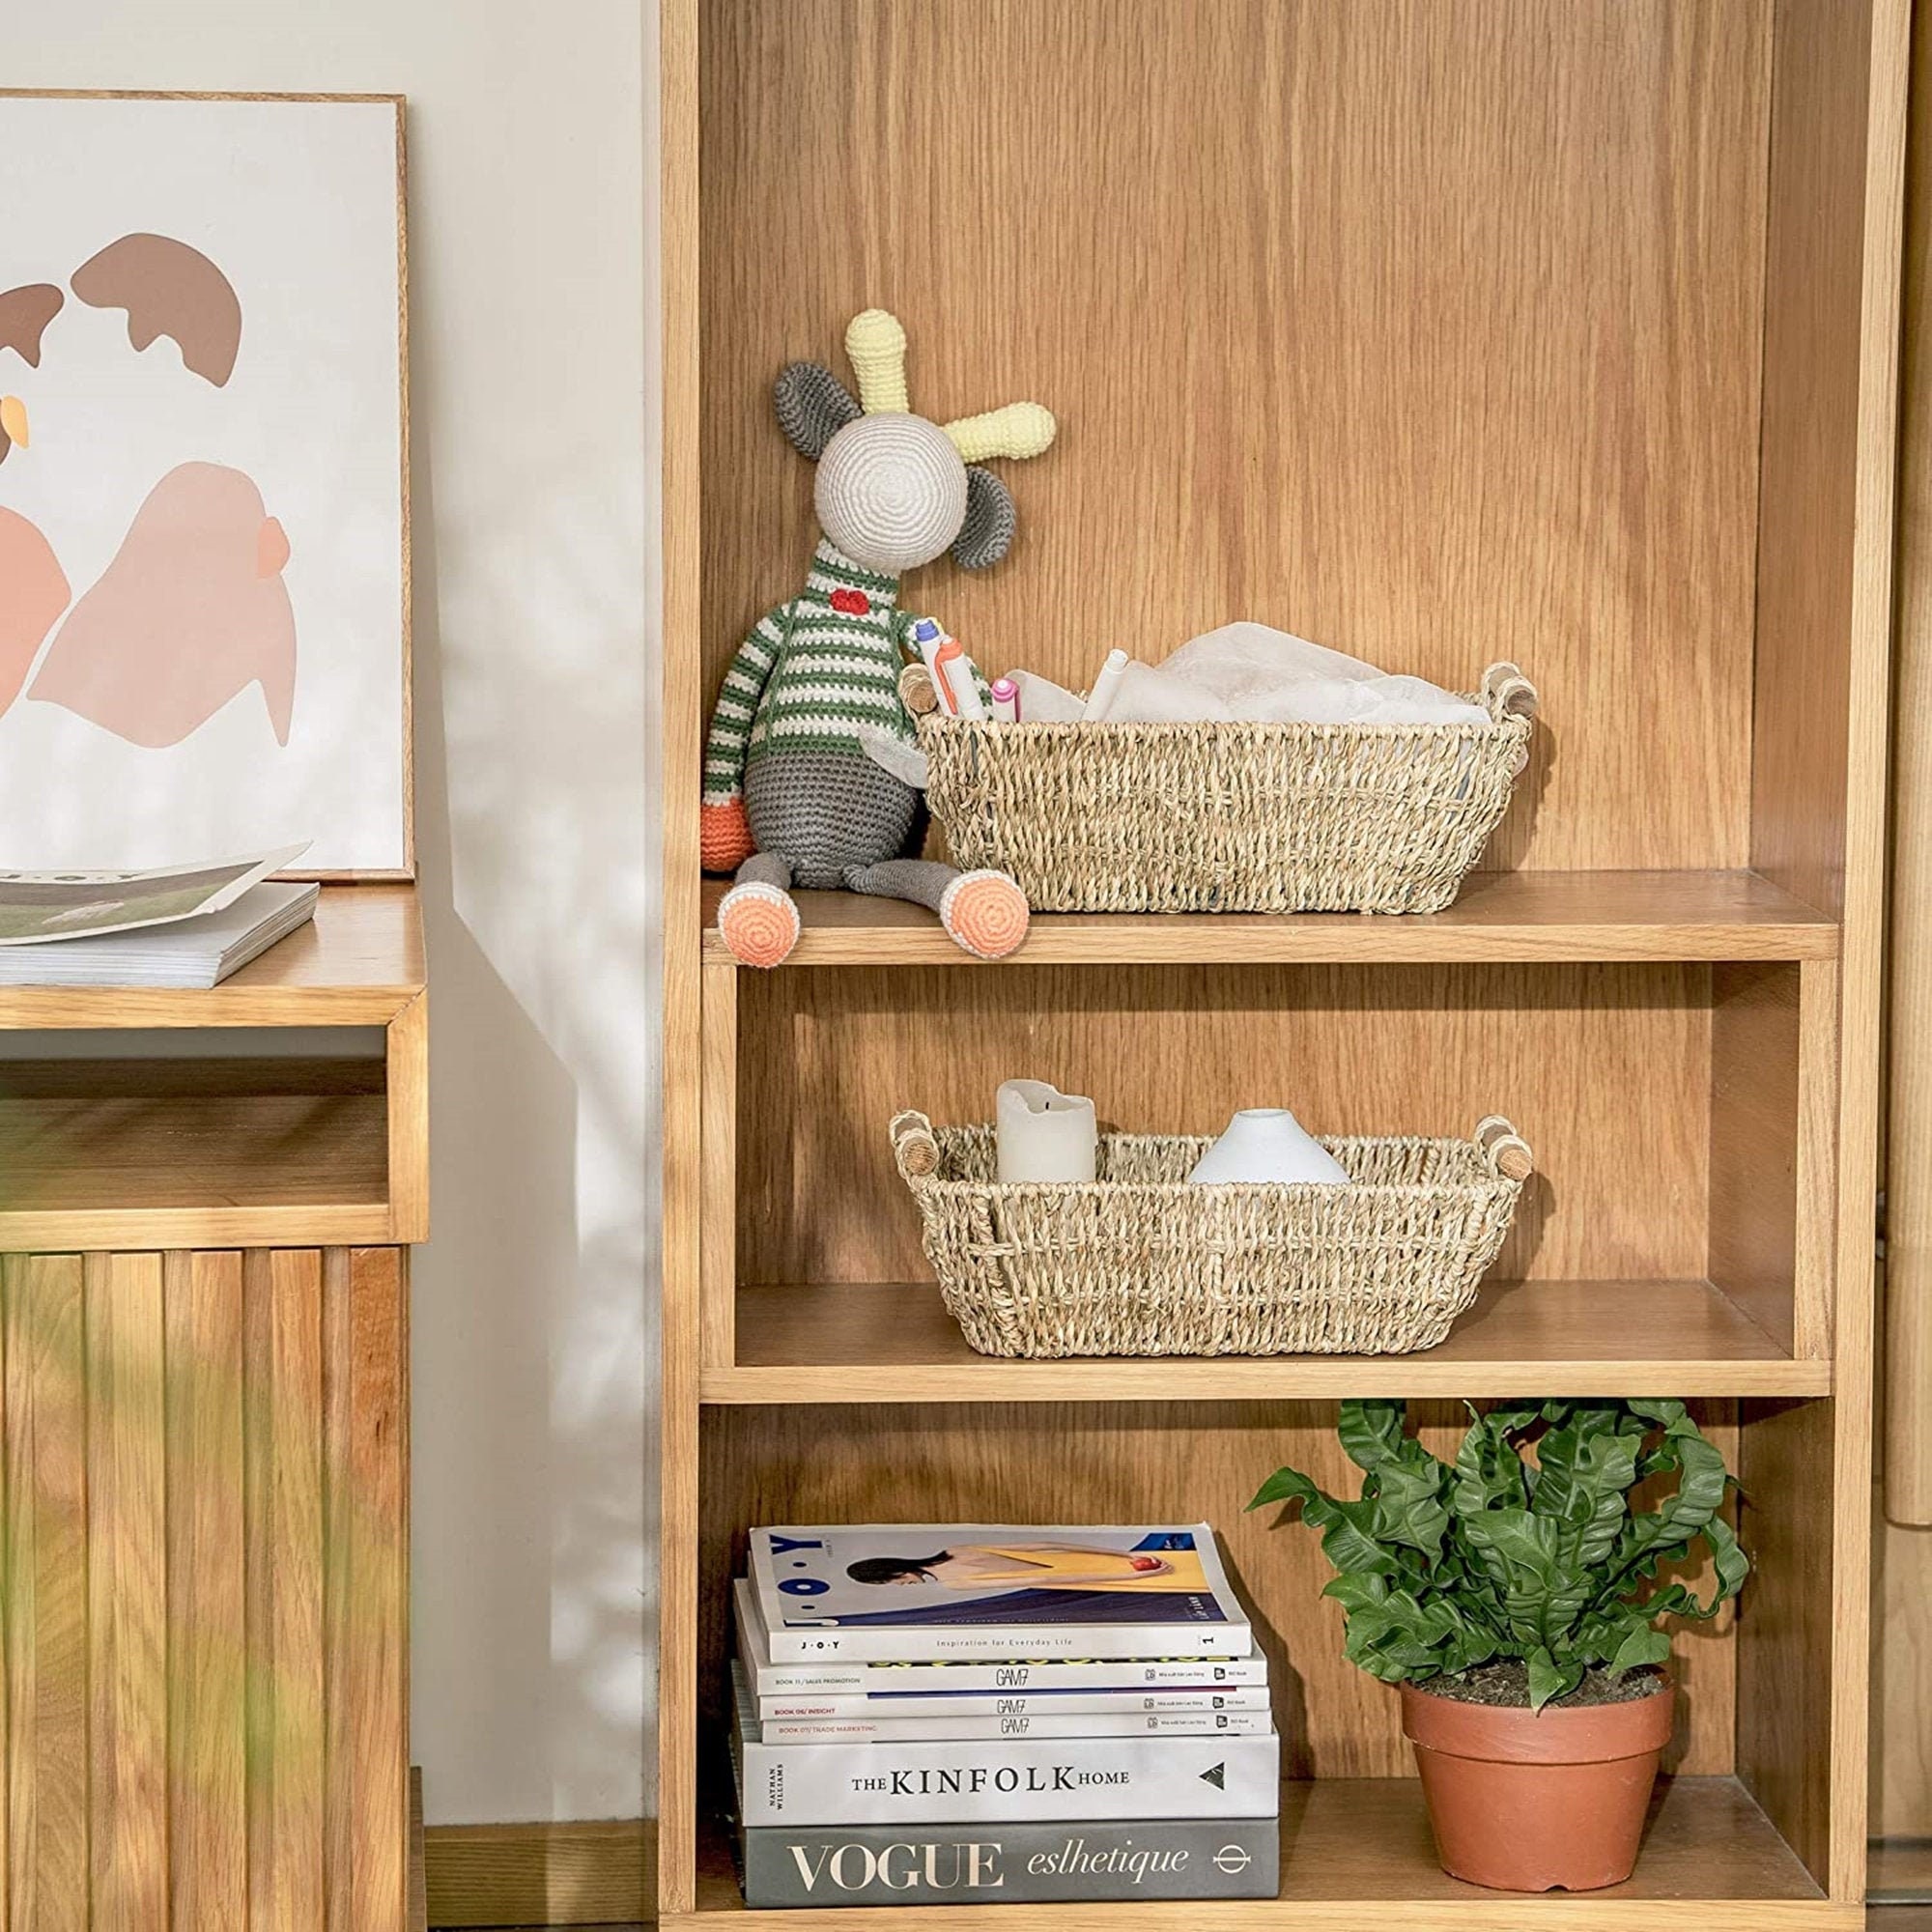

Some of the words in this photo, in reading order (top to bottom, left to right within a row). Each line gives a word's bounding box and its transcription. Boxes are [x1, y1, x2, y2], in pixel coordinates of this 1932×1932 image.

[1009, 1638, 1050, 1647] Everyday
[852, 1778, 887, 1791] THE
[890, 1766, 1076, 1795] KINFOLK
[1079, 1771, 1130, 1785] HOME
[786, 1843, 1004, 1892] VOGUE
